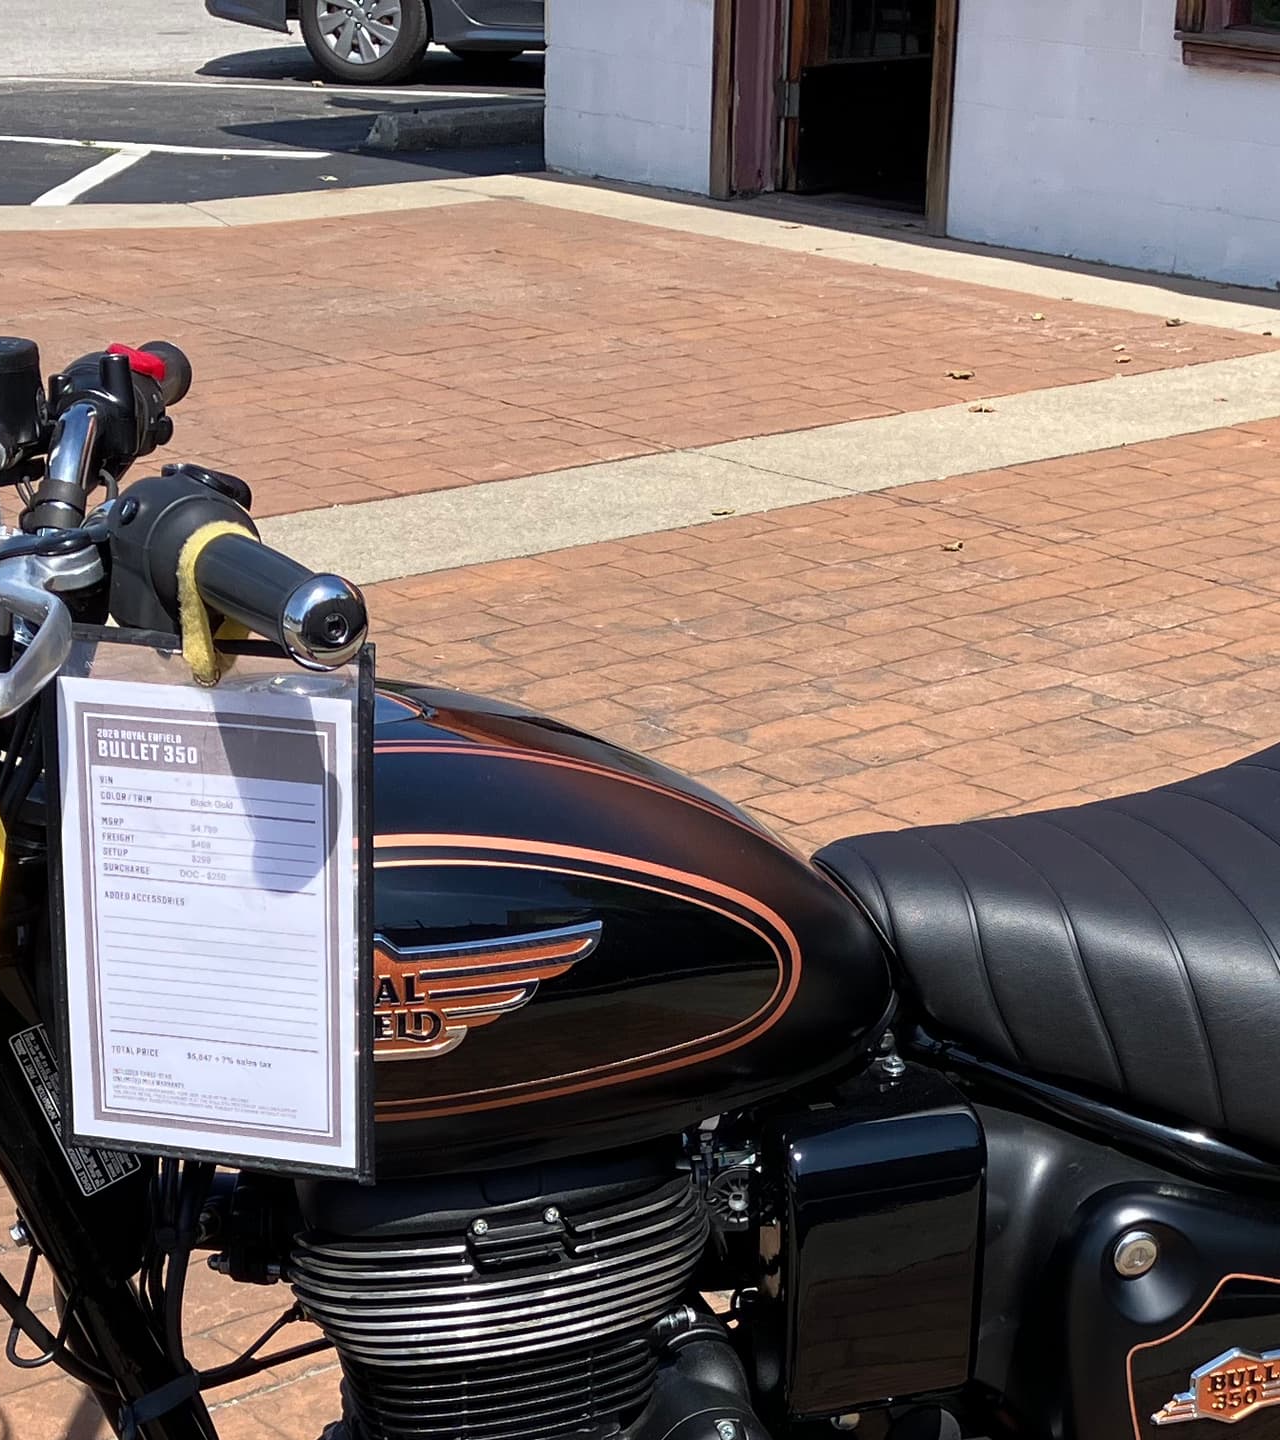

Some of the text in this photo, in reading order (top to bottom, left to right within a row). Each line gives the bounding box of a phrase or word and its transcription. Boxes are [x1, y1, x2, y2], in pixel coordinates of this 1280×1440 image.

[120, 729, 147, 742] ROYAL
[148, 732, 182, 744] ENFIELD
[97, 739, 198, 764] BULLET 350
[99, 775, 113, 785] VIN
[179, 868, 199, 879] DOC
[136, 1047, 159, 1057] PRICE
[1211, 1386, 1258, 1411] 350
